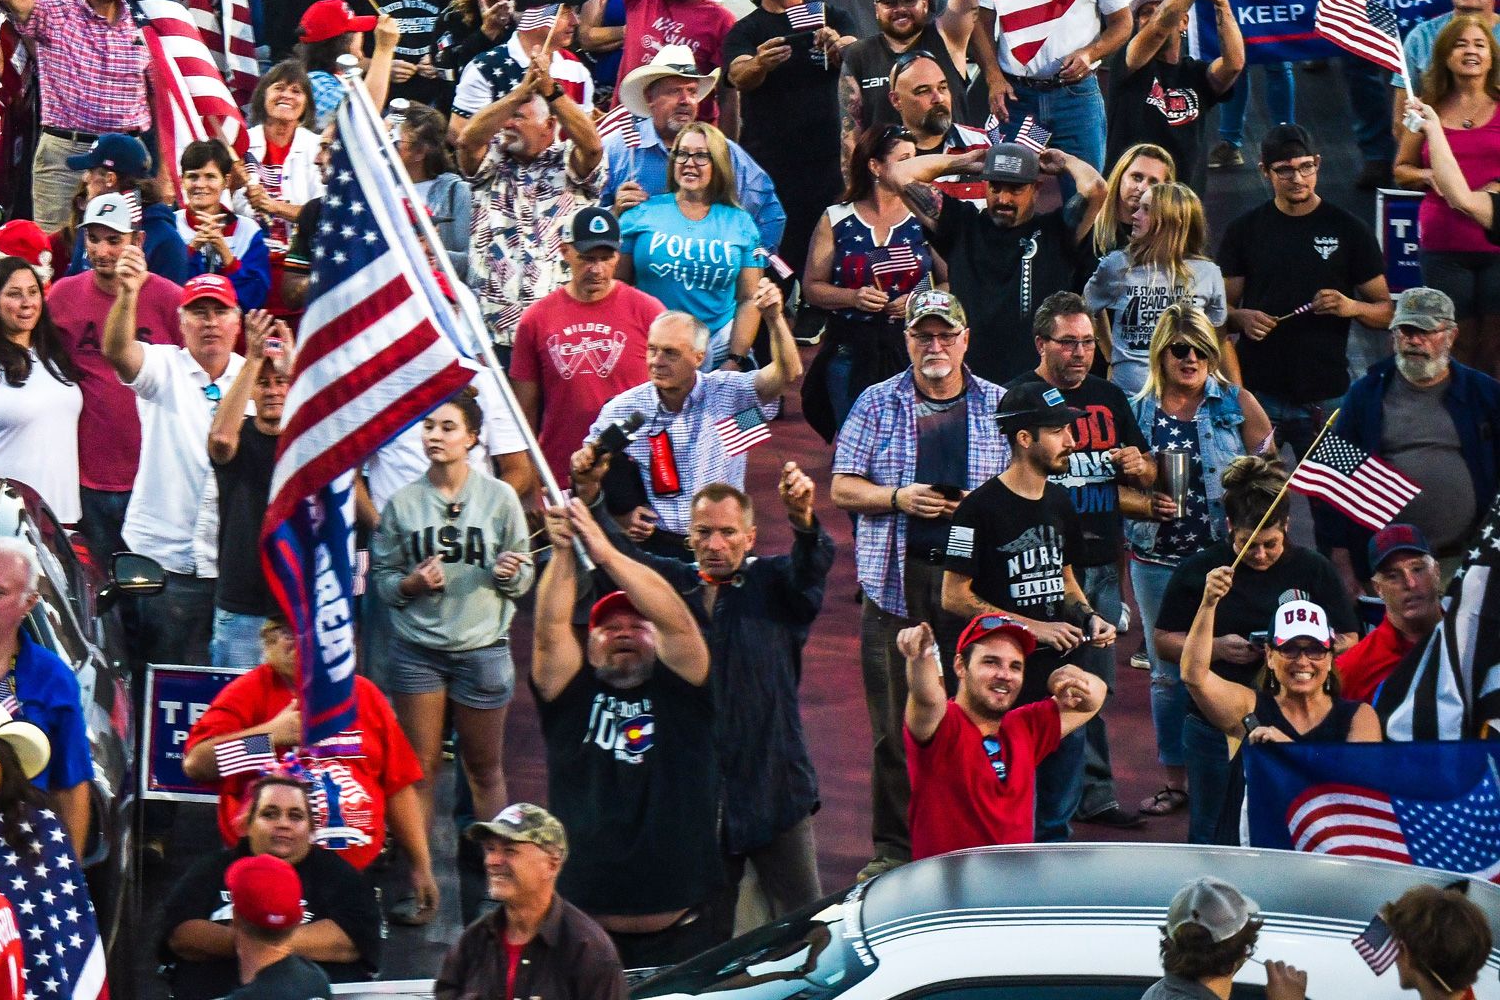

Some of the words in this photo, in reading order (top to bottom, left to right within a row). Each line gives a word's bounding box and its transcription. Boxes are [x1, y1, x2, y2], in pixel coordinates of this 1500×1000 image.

[1238, 3, 1305, 25] KEEP
[862, 76, 889, 89] car
[96, 203, 117, 217] P
[649, 231, 733, 266] POLICE
[673, 260, 735, 292] WIFE
[1126, 286, 1139, 296] WE
[1140, 286, 1166, 296] STAND
[562, 322, 611, 336] WILDER
[412, 526, 484, 567] USA
[1007, 546, 1064, 579] NURS
[1017, 578, 1063, 597] BADAS
[1284, 608, 1319, 626] USA
